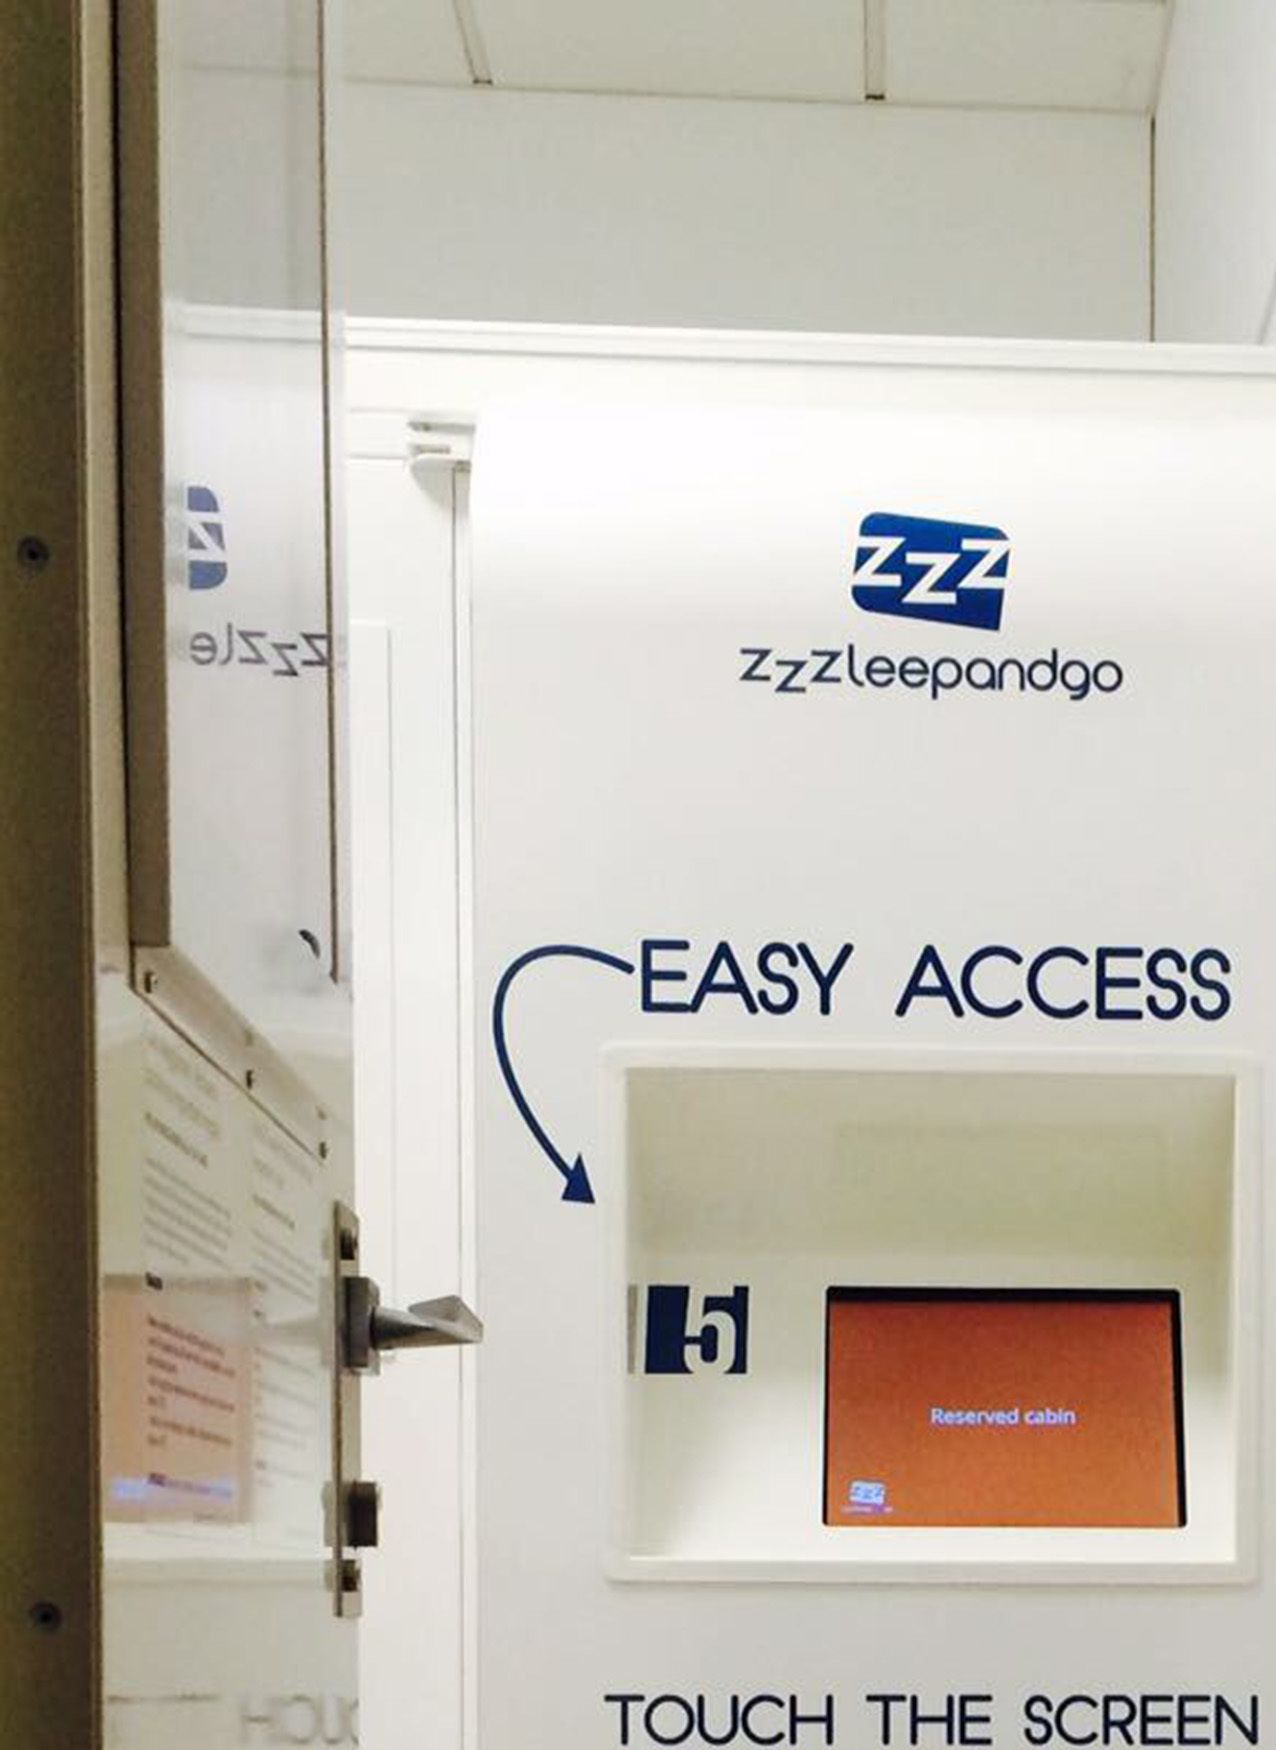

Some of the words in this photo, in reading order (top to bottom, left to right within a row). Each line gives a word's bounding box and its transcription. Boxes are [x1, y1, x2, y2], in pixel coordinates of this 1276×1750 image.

[641, 939, 854, 1016] EASY
[895, 944, 1231, 1021] ACCESS
[931, 1407, 1019, 1425] Reserved
[1023, 1407, 1077, 1425] cabin
[604, 1694, 834, 1746] TOUCH
[865, 1694, 993, 1746] THE
[1023, 1694, 1260, 1746] SCREEN
